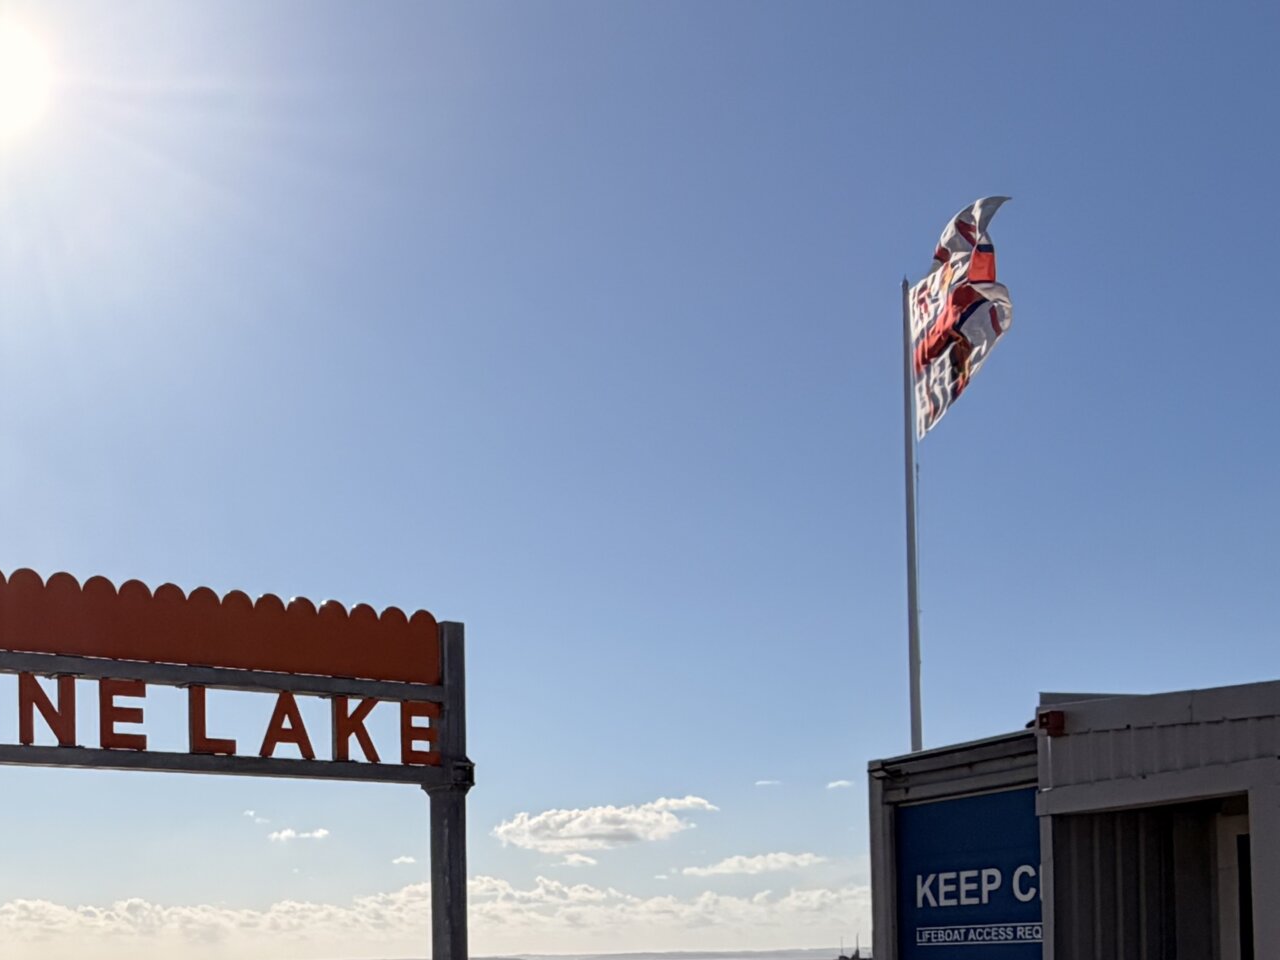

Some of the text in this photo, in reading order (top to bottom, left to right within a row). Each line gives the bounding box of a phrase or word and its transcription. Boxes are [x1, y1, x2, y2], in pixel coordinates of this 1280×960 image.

[188, 684, 442, 766] LAKE
[916, 864, 1043, 908] KEEP C
[916, 928, 966, 943] LIFEBOAT
[968, 926, 1014, 941] ACCESS
